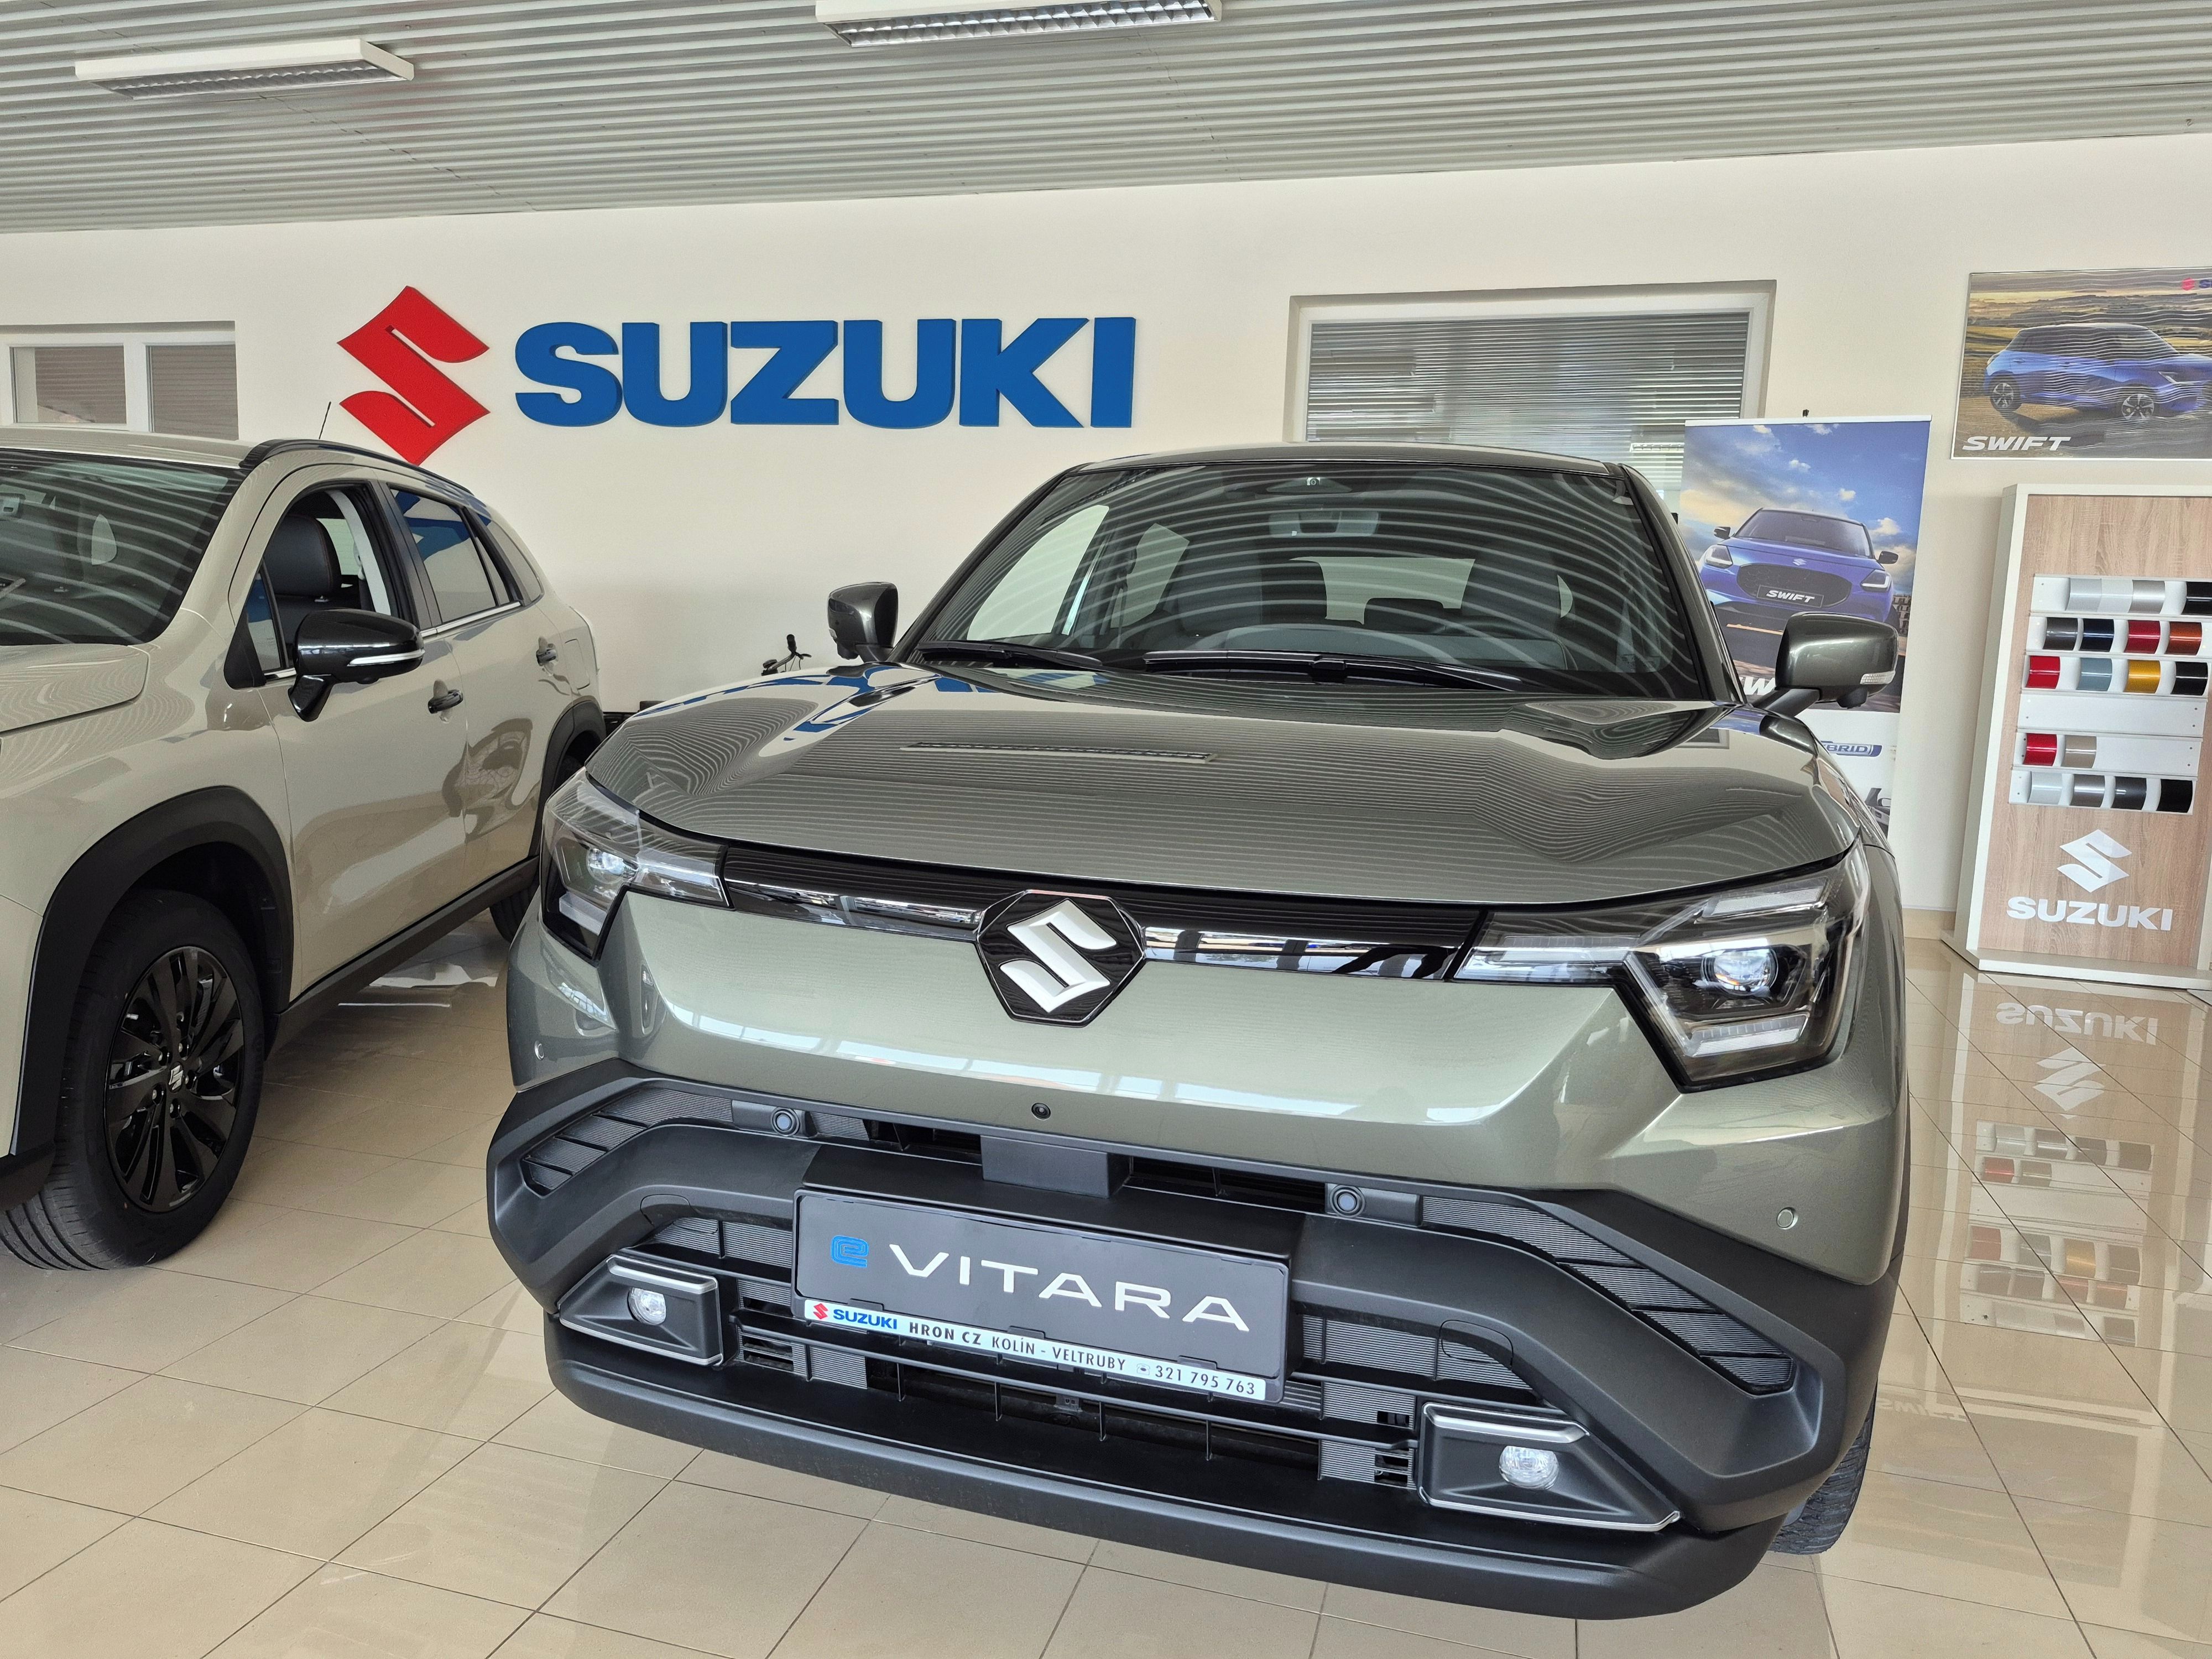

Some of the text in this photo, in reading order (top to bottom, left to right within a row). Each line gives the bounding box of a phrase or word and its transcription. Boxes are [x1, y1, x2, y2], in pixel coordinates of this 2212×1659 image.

[515, 317, 1136, 429] SUZUKI
[1962, 436, 2071, 451] SWIFT
[1766, 590, 1815, 603] SWIFT
[1824, 744, 1868, 753] BRID
[2006, 896, 2173, 931] SUZUKI
[889, 1244, 1250, 1331] VITARA
[833, 1309, 898, 1329] SUZUKI
[910, 1322, 954, 1340] HRON
[962, 1331, 982, 1345] CZ
[992, 1336, 1035, 1355] KOLÍN
[1052, 1347, 1126, 1371] VELTRUBY
[1155, 1365, 1182, 1382] 321
[1191, 1371, 1219, 1389] 795
[1226, 1378, 1255, 1395] 763
